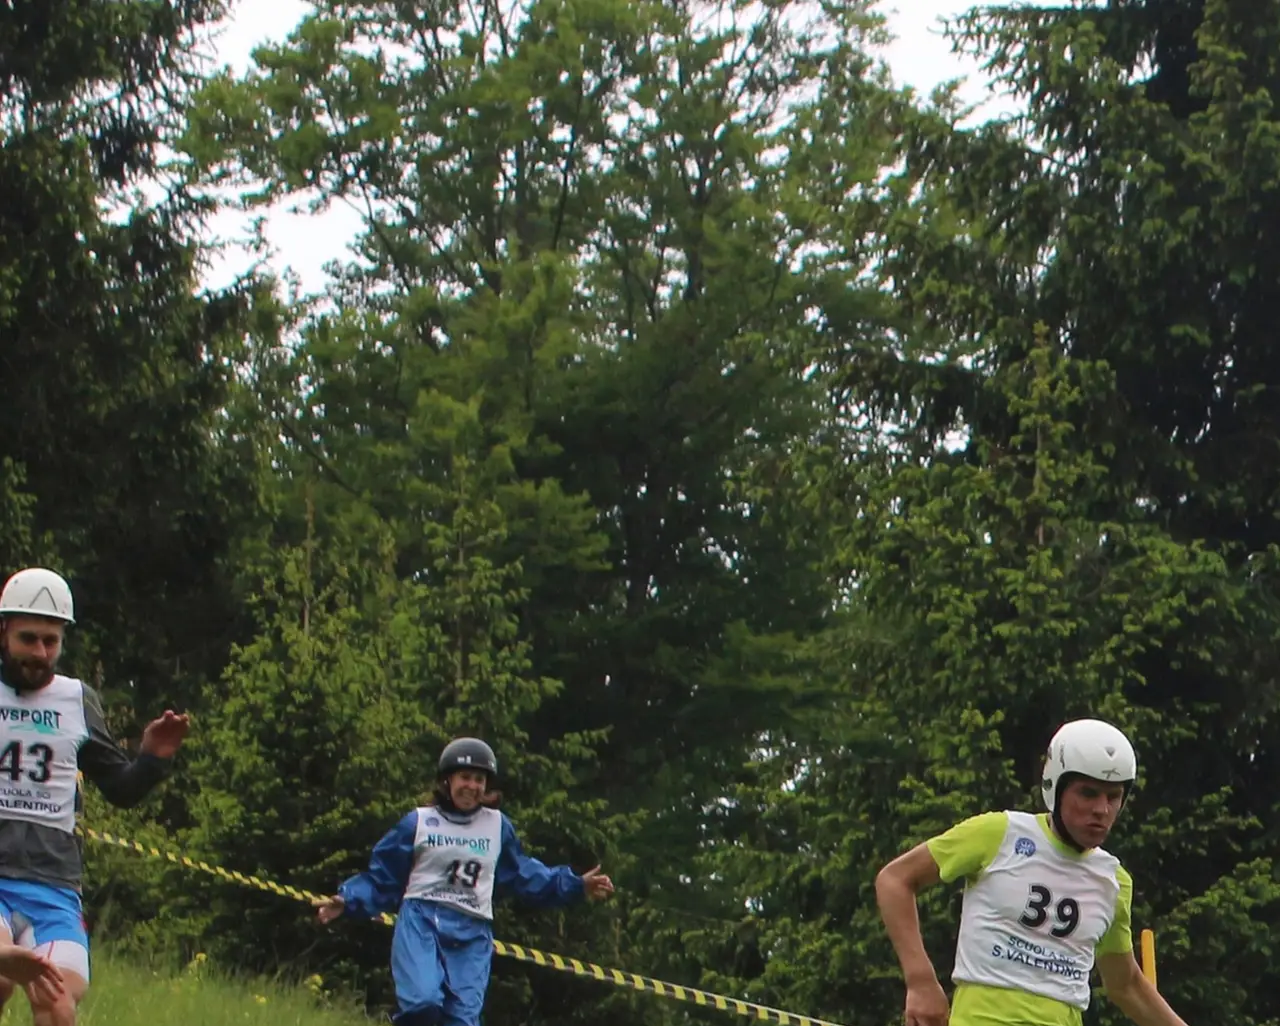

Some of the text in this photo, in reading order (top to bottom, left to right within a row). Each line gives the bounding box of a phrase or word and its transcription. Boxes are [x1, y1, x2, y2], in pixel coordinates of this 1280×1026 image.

[0, 740, 54, 783] 43
[427, 833, 491, 851] NEWSPORT
[1017, 882, 1080, 938] 39
